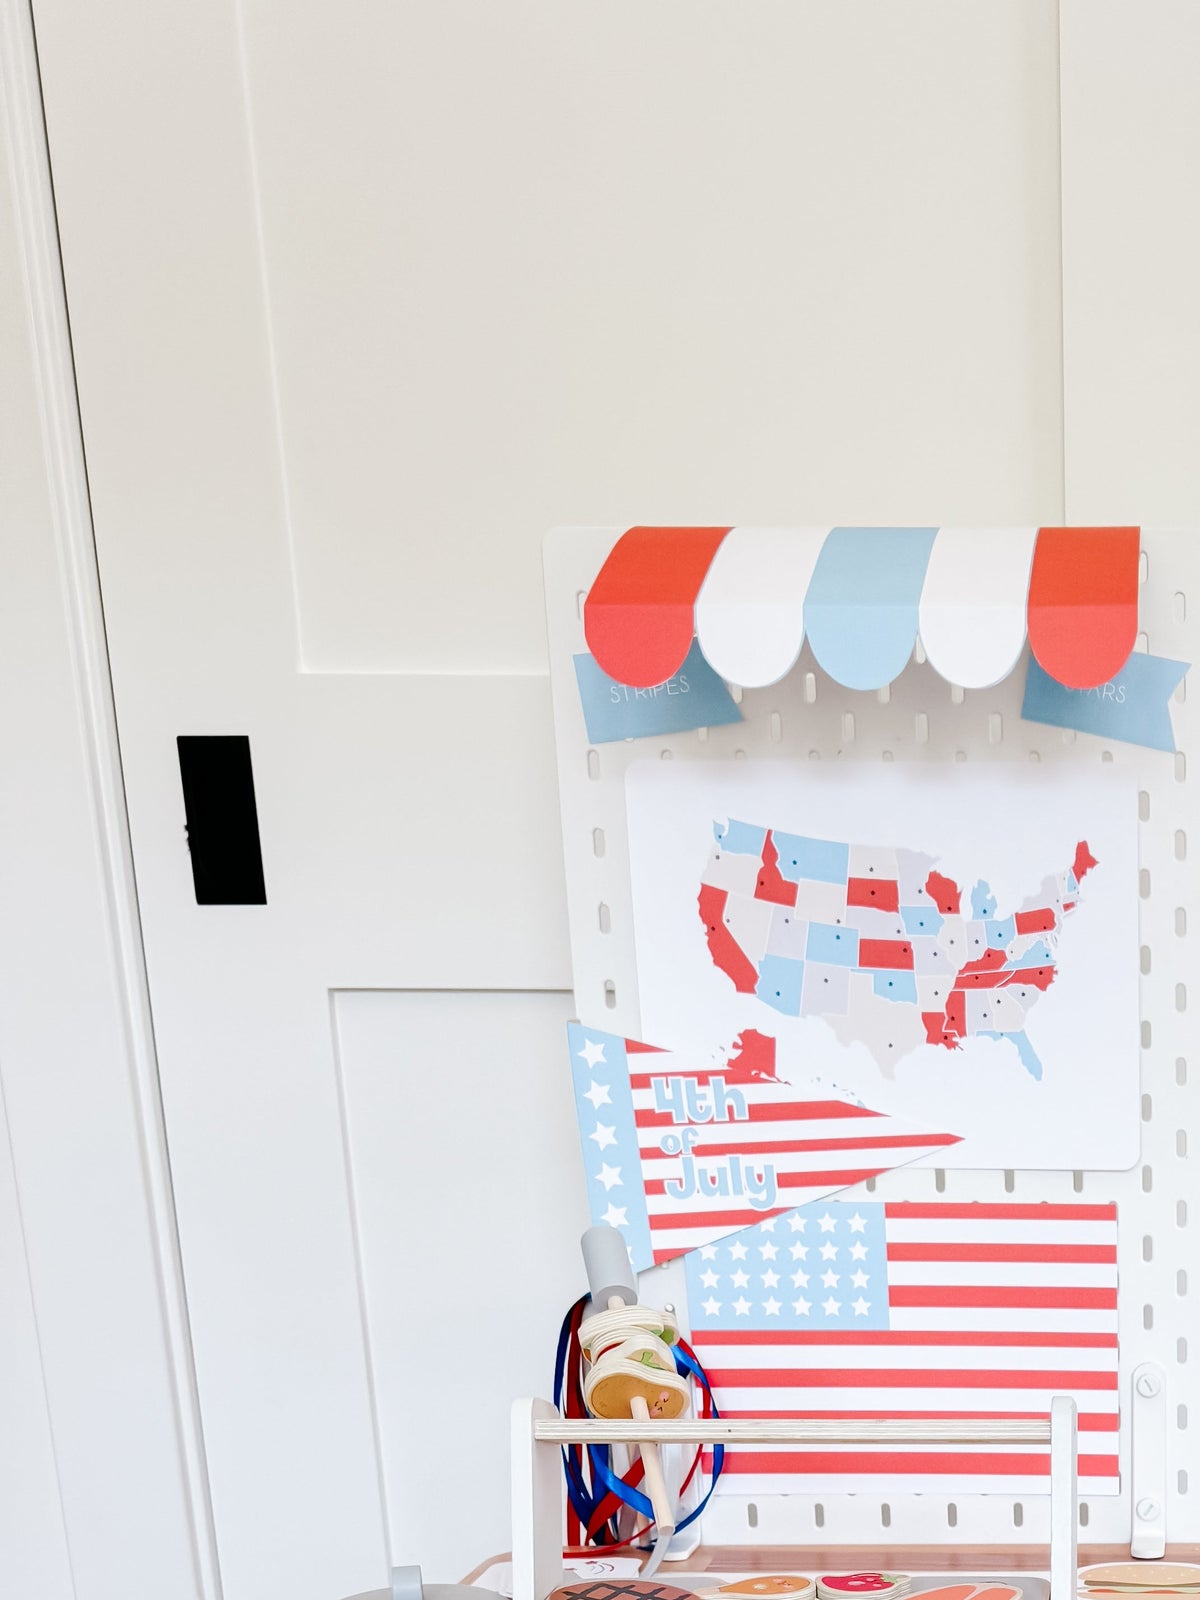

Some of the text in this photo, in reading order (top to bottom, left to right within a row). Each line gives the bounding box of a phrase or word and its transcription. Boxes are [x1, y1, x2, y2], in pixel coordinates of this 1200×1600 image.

[651, 1076, 749, 1124] 4th
[660, 1127, 698, 1156] of
[664, 1154, 777, 1211] July
